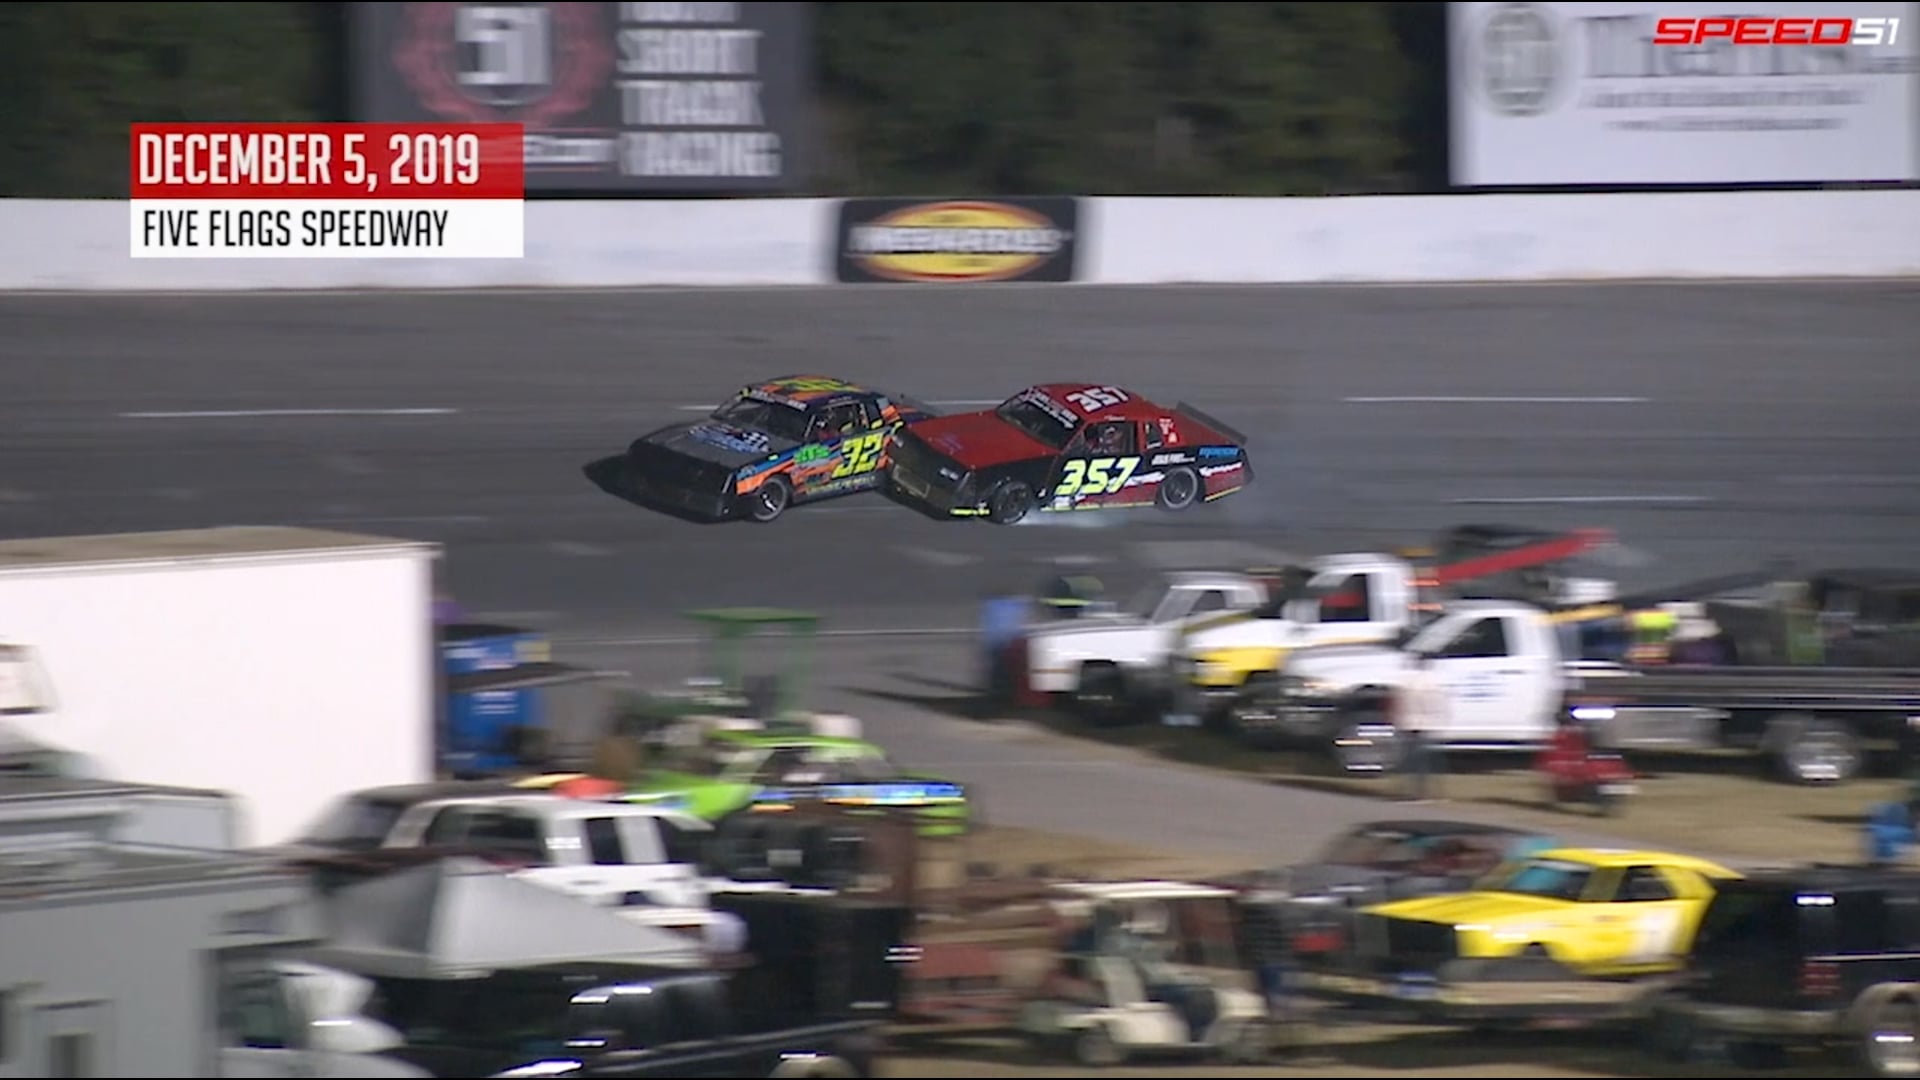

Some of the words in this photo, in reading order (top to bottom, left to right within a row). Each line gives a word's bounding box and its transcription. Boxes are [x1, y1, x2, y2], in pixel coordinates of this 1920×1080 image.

[1066, 386, 1129, 413] 357
[832, 433, 885, 478] 32
[1055, 456, 1141, 495] 357
